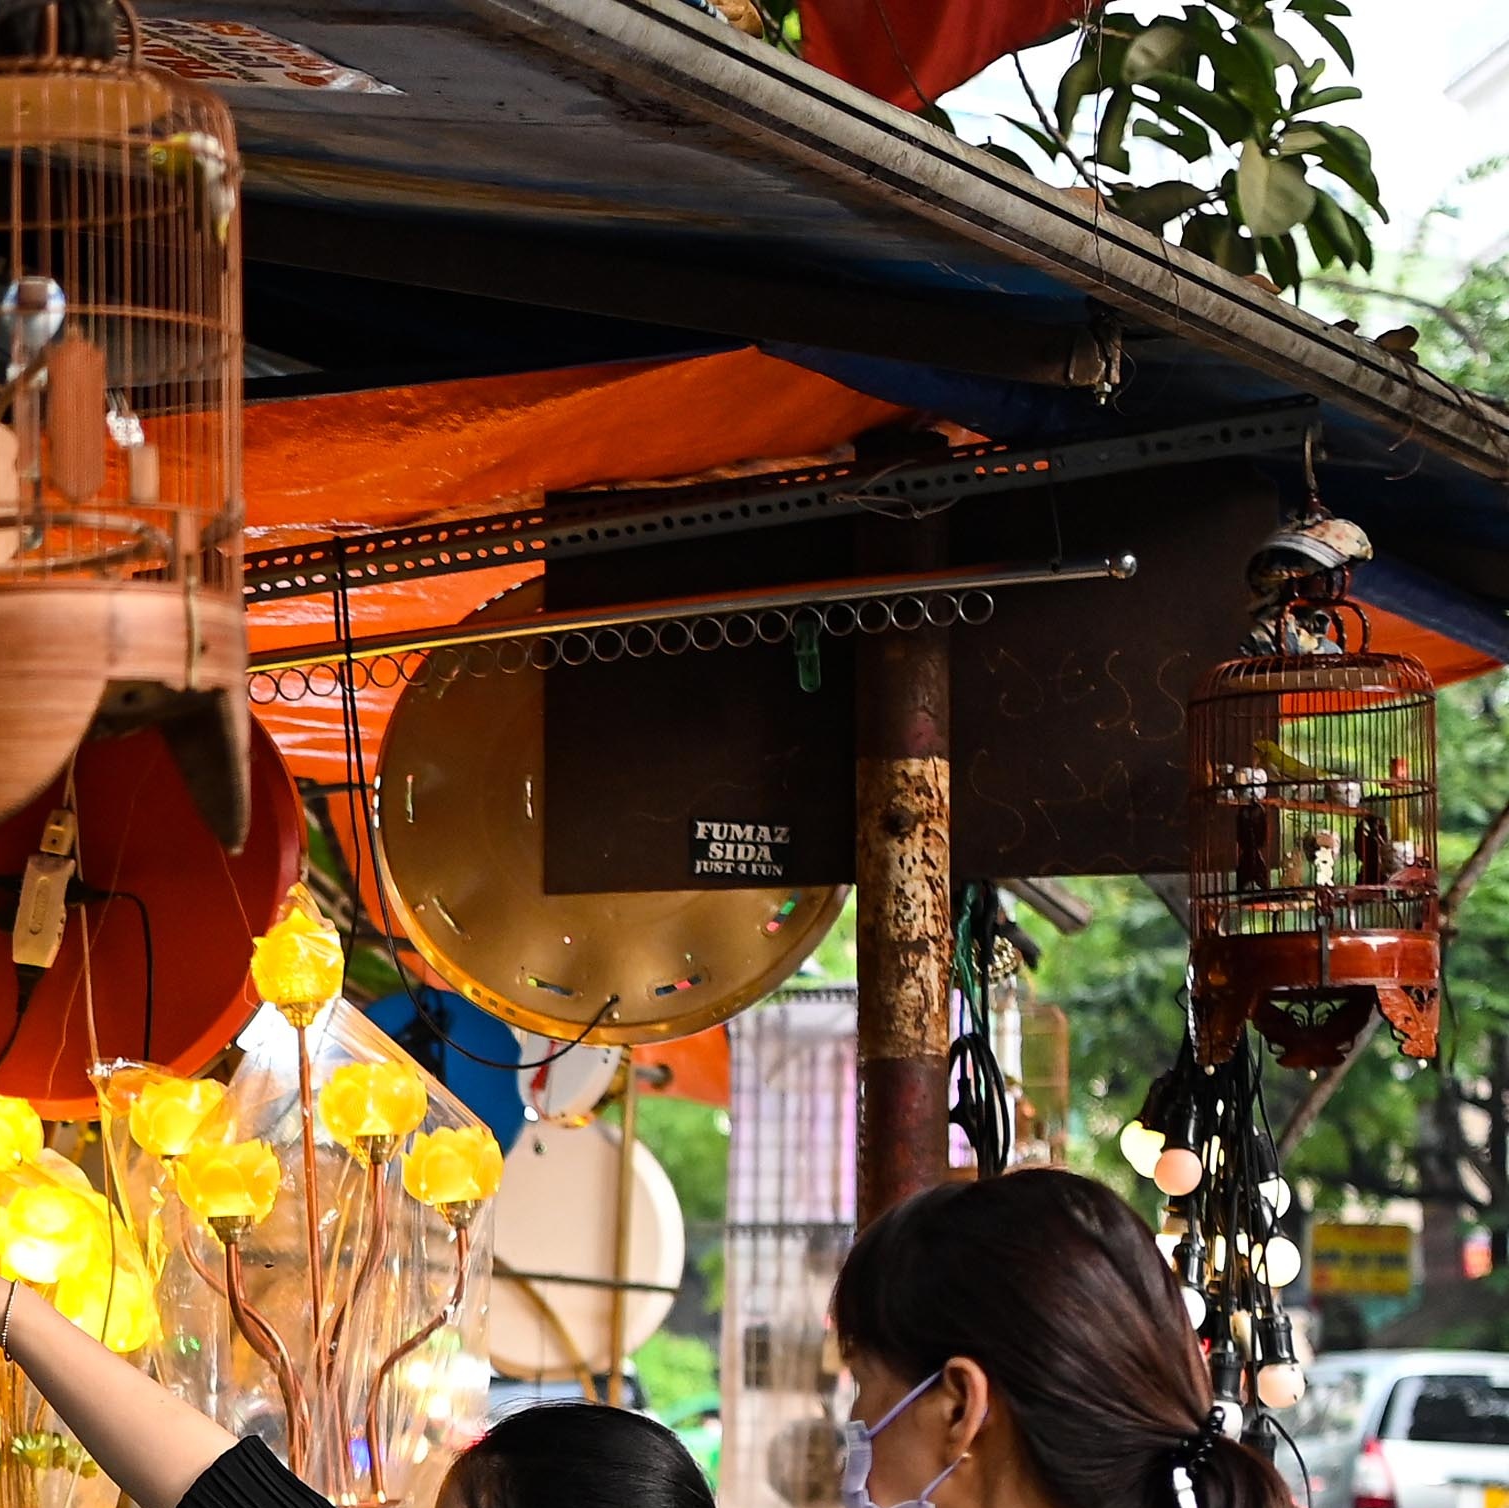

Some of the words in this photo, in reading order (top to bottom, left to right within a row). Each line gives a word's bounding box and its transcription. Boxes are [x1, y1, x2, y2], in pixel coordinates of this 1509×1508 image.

[694, 821, 790, 844] FUMAZ
[708, 842, 773, 862] SIDA
[695, 860, 735, 874] JUST
[751, 863, 783, 877] FUN
